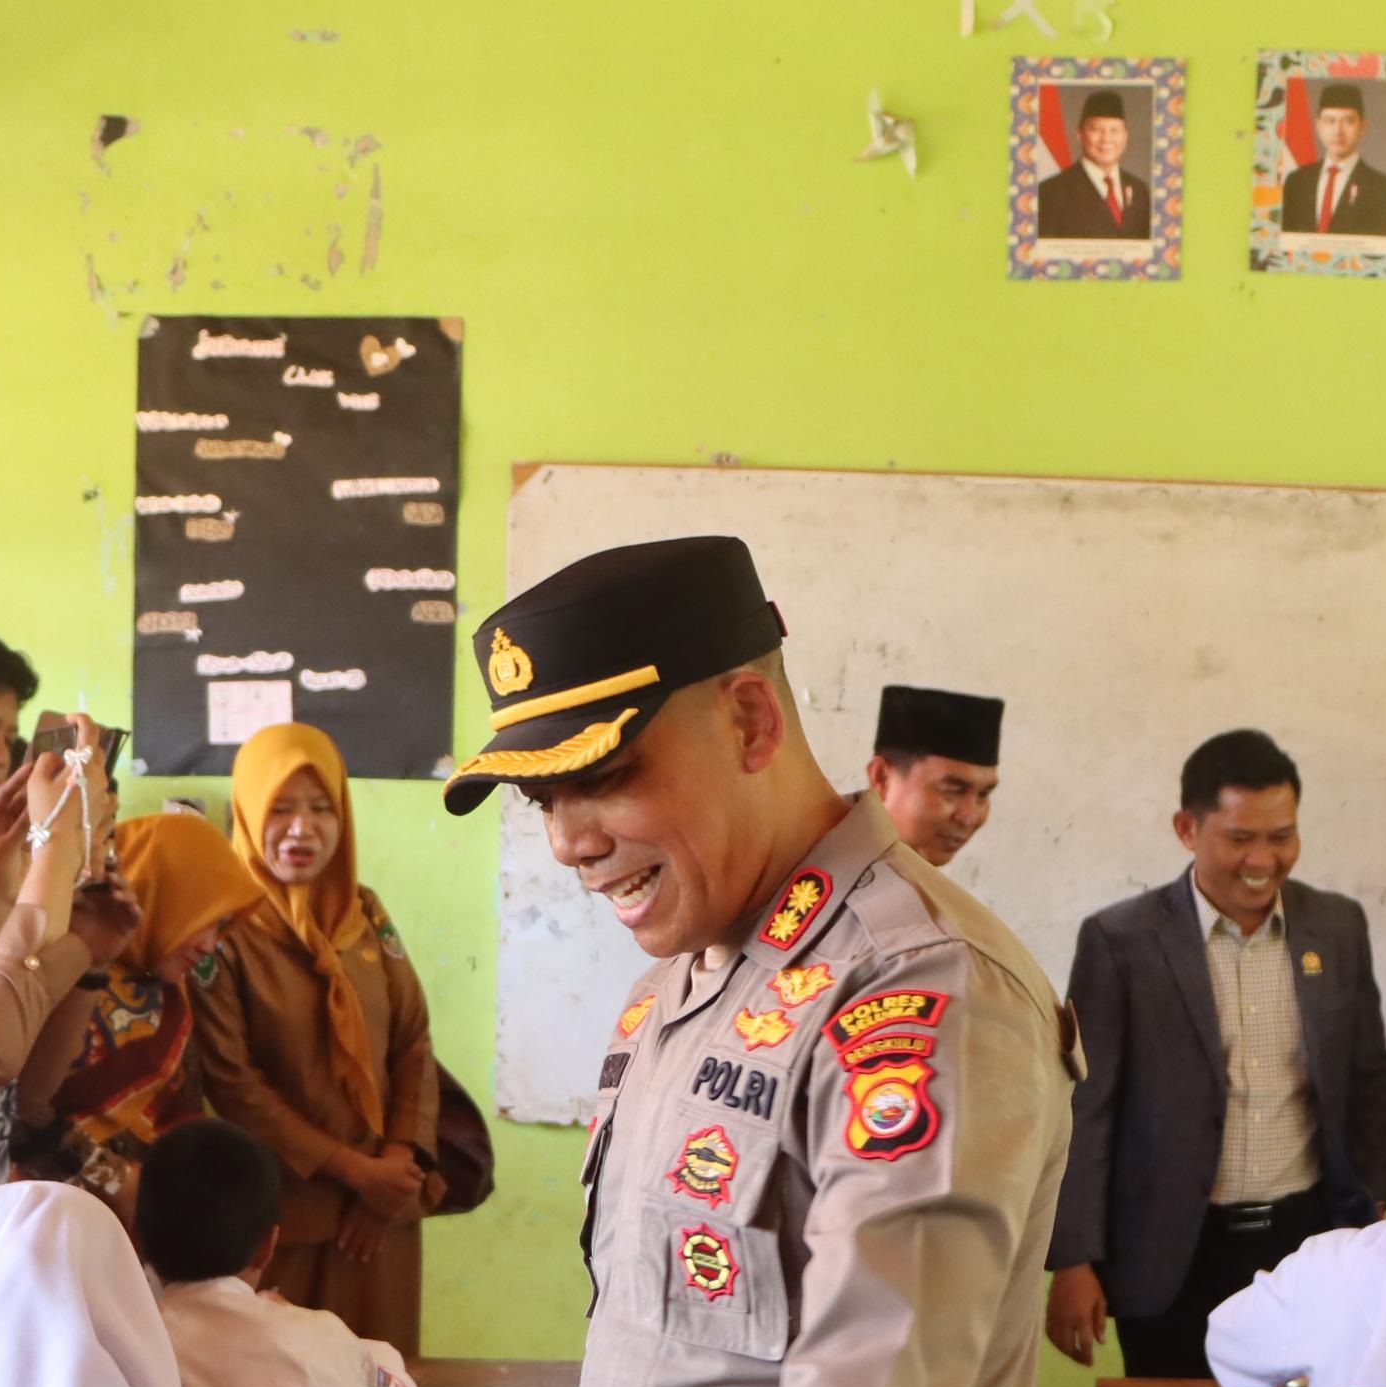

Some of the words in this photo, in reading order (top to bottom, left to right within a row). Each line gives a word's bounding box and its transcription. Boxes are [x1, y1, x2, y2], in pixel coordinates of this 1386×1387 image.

[839, 995, 926, 1028] POLRES
[845, 1007, 918, 1036] SELUMA
[844, 1037, 926, 1064] BENGKULU
[692, 1056, 778, 1121] POLRI
